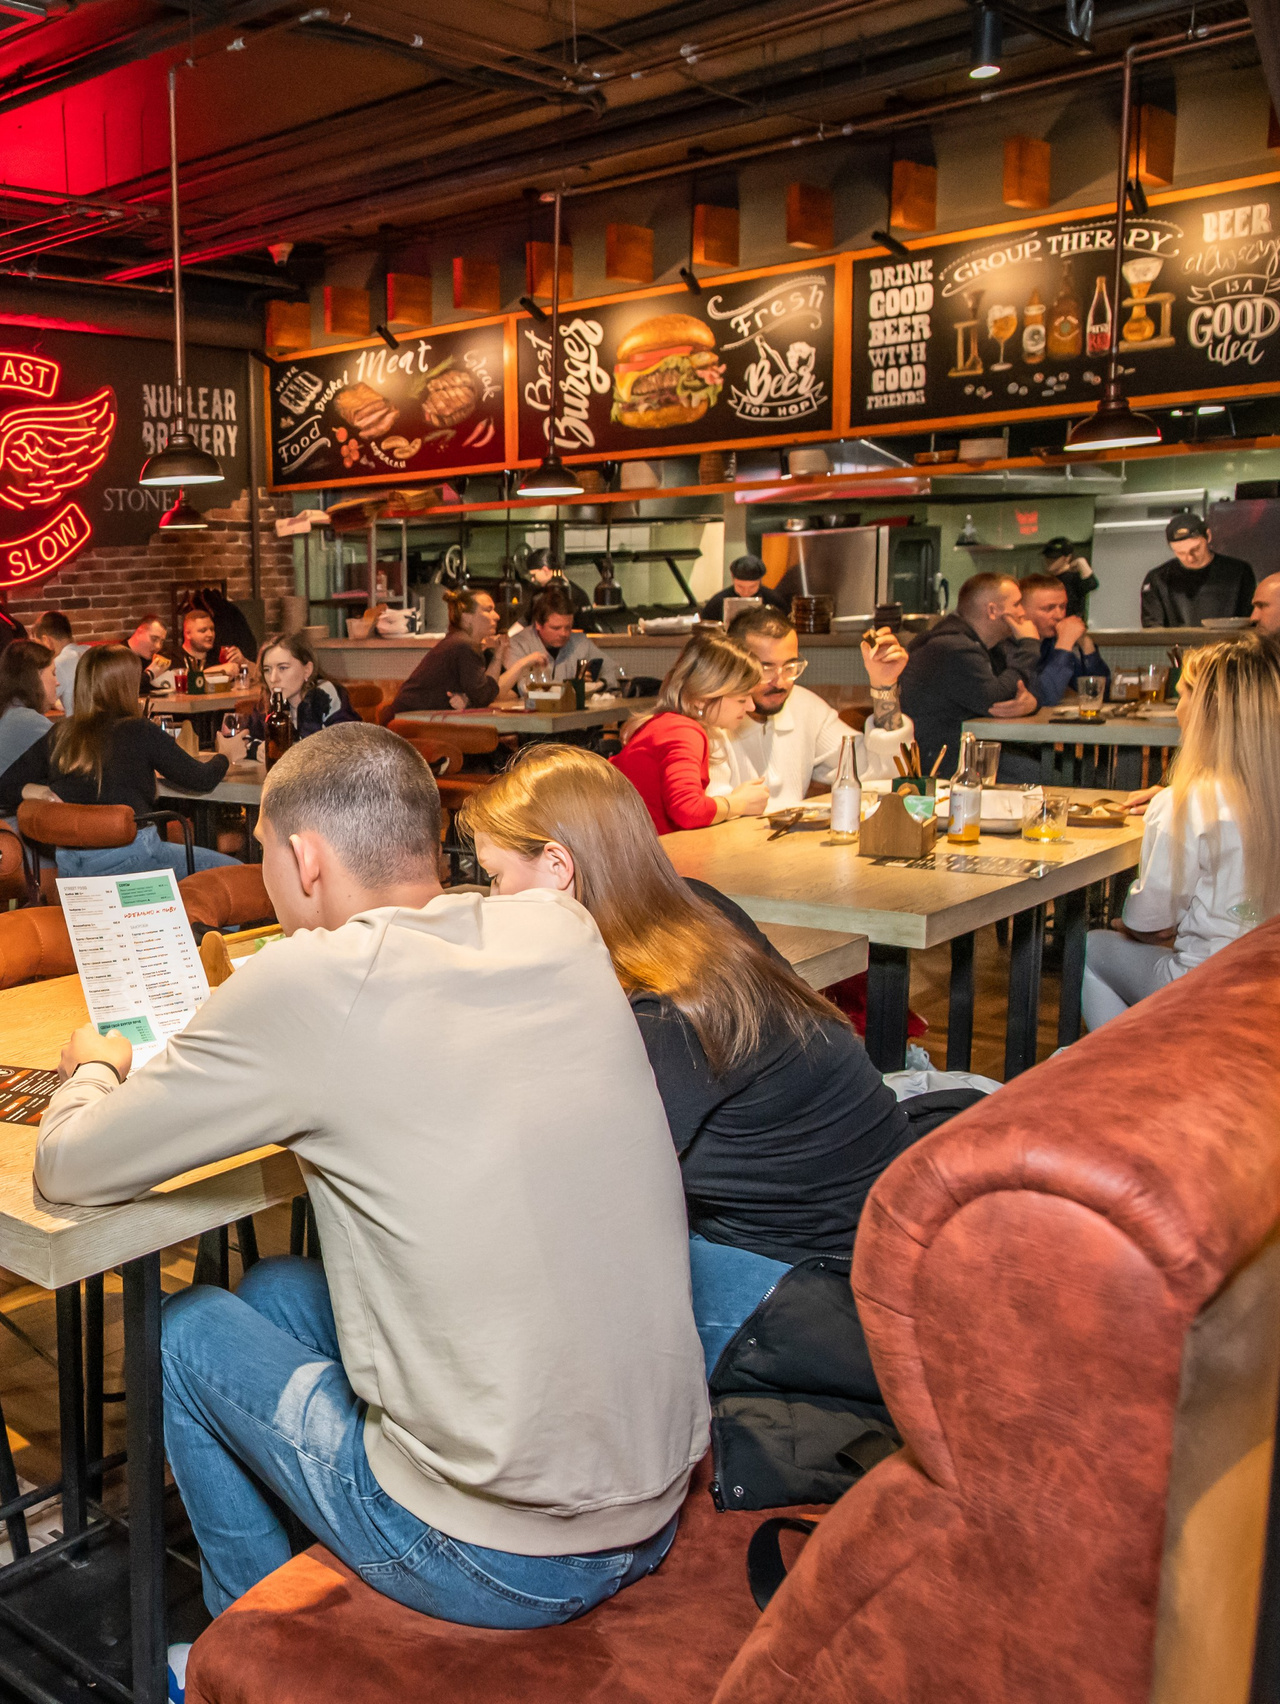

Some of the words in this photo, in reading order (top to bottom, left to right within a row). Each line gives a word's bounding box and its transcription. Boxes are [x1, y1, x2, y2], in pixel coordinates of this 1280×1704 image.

[1203, 203, 1273, 243] BEER
[870, 259, 933, 290] DRINK
[954, 240, 1042, 283] GROUP
[1184, 239, 1280, 276] alway
[730, 284, 824, 337] Fresh
[869, 283, 934, 319] GOOD
[869, 313, 932, 347] BEER
[1188, 297, 1280, 348] GOOD
[356, 340, 432, 384] Meat
[869, 341, 927, 368] WITH
[1207, 334, 1264, 367] idea
[524, 330, 553, 411] Best
[744, 359, 816, 405] Beer
[872, 364, 926, 393] GOOD
[142, 384, 236, 421] NULEAR
[745, 403, 770, 416] TOP
[778, 400, 810, 416] HOP
[867, 390, 926, 410] FRIENDS
[141, 421, 238, 457] BRWERY
[278, 421, 321, 463] Food
[103, 487, 175, 512] STONE
[9, 515, 78, 577] SLOW
